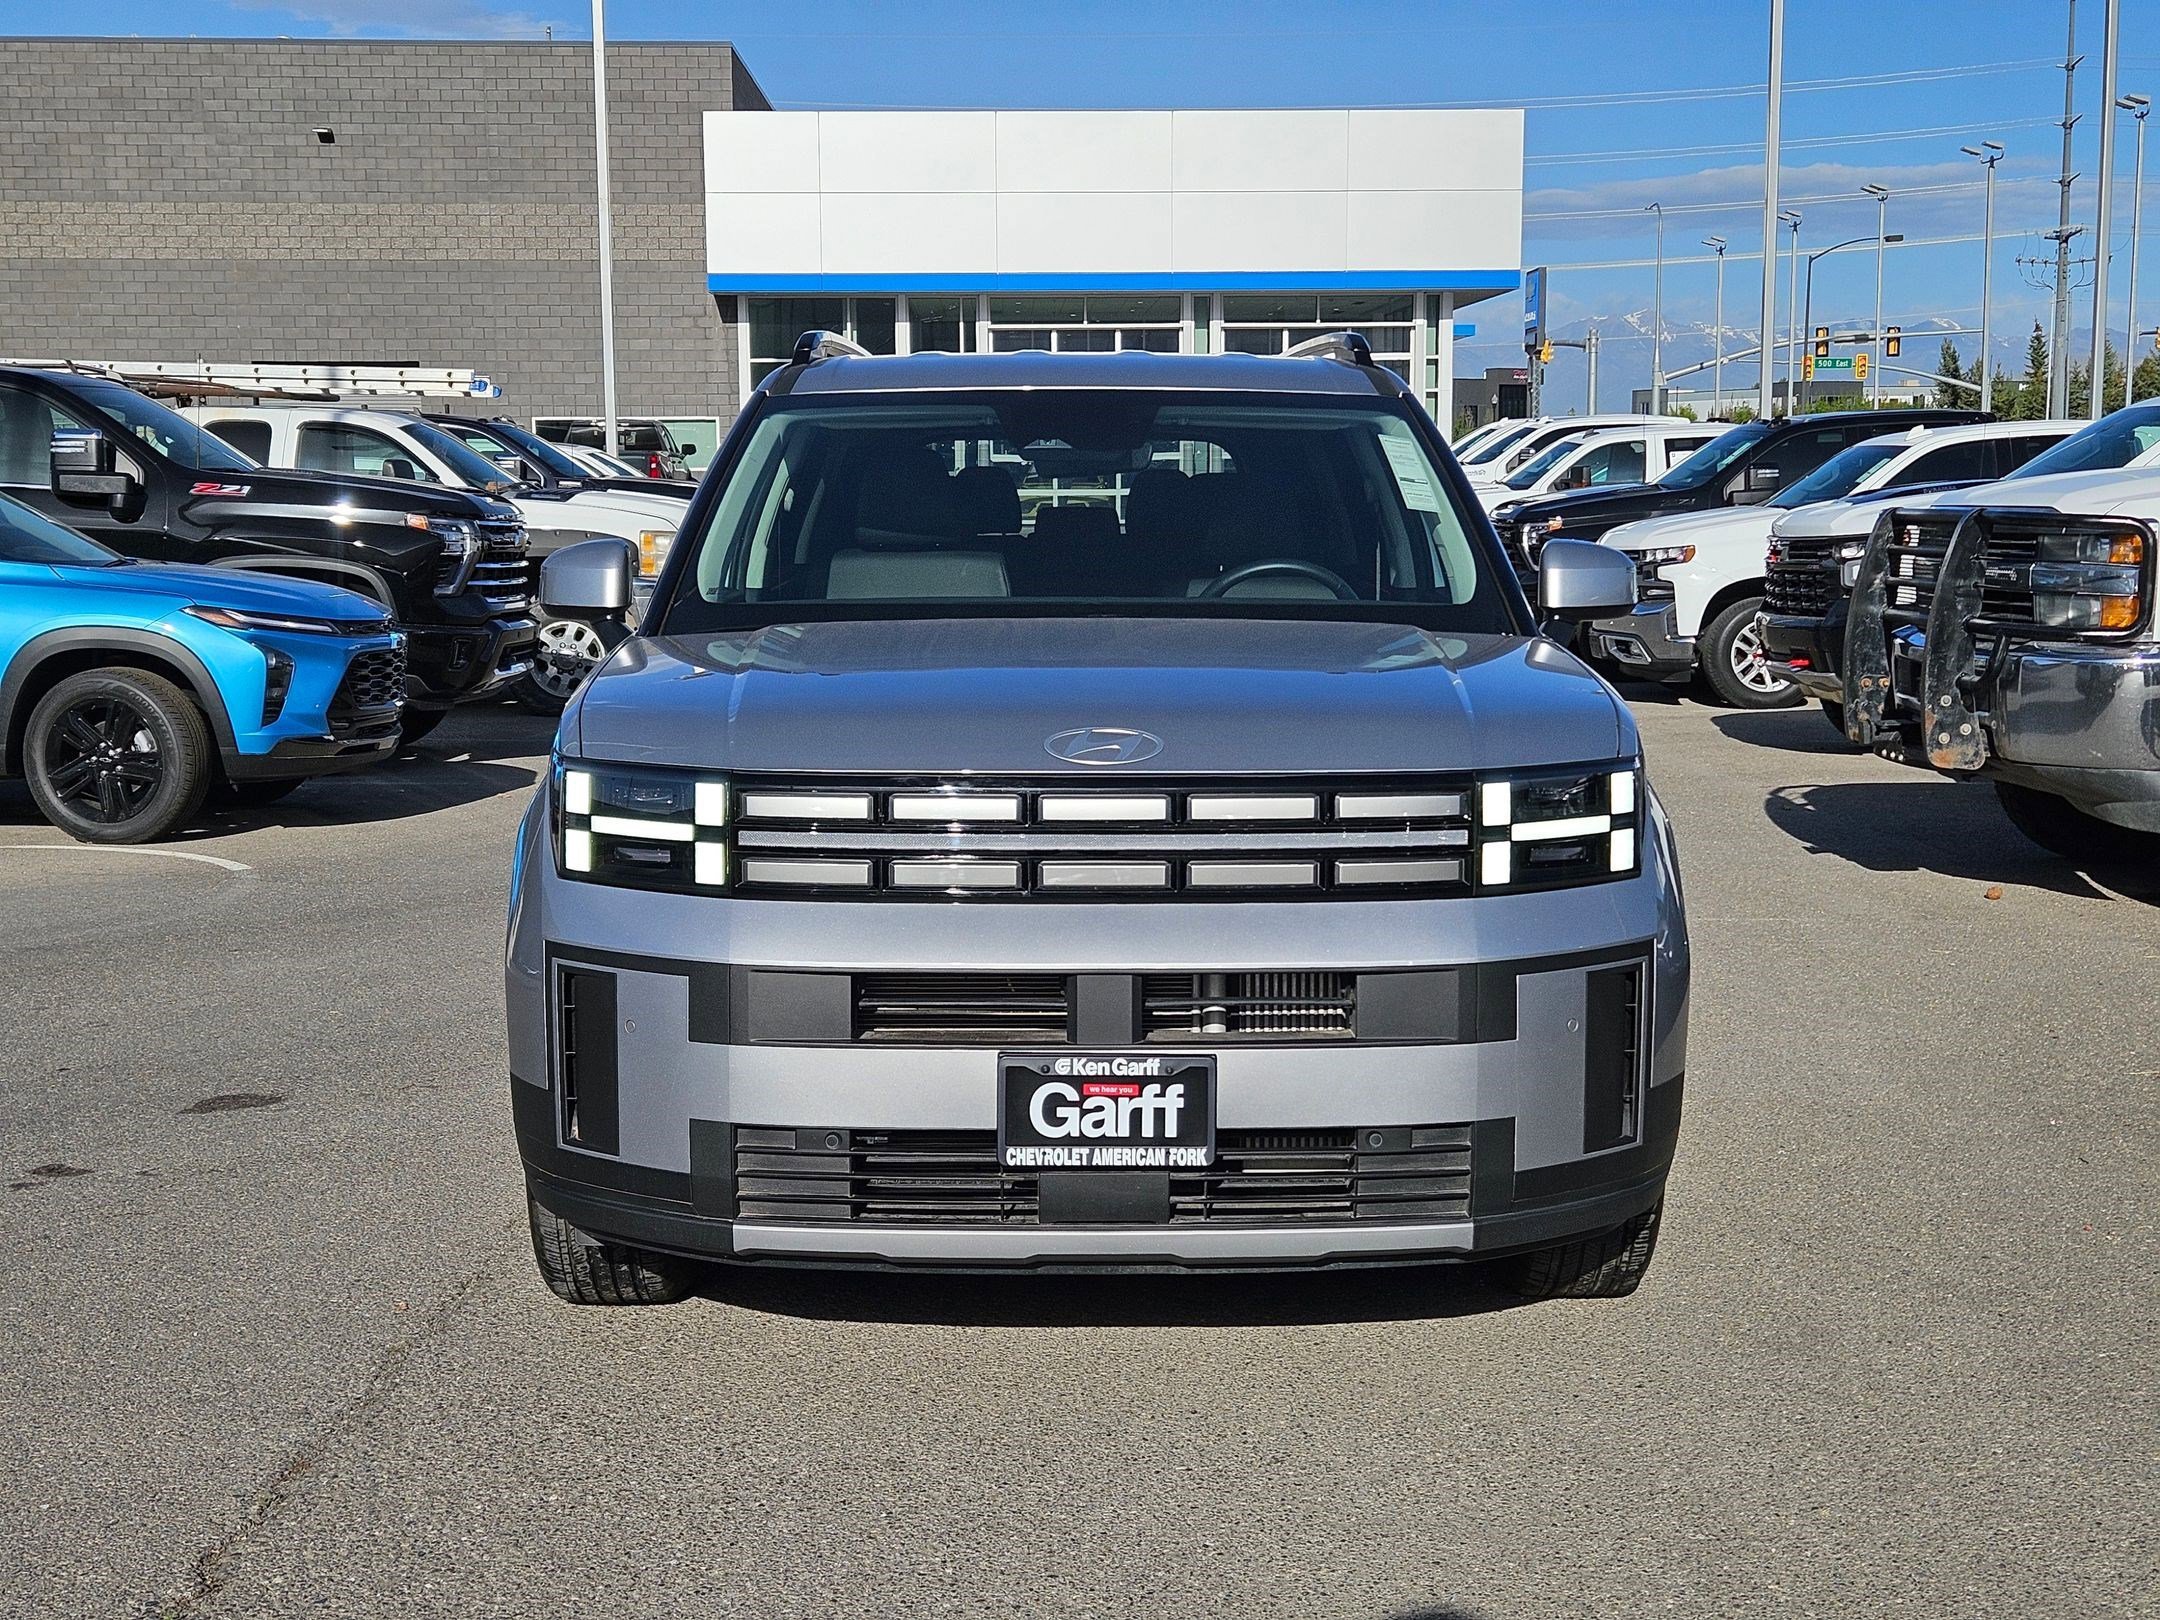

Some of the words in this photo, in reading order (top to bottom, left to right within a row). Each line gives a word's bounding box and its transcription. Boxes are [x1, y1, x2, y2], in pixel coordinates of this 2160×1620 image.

[189, 482, 251, 496] Z71
[1072, 1057, 1110, 1076] Ken
[1112, 1057, 1160, 1076] Garff
[1119, 1087, 1133, 1095] you
[1029, 1082, 1184, 1138] Garff
[1006, 1147, 1090, 1166] CHEVROLET
[1092, 1147, 1166, 1166] AMERICAN
[1168, 1147, 1207, 1166] FORK
